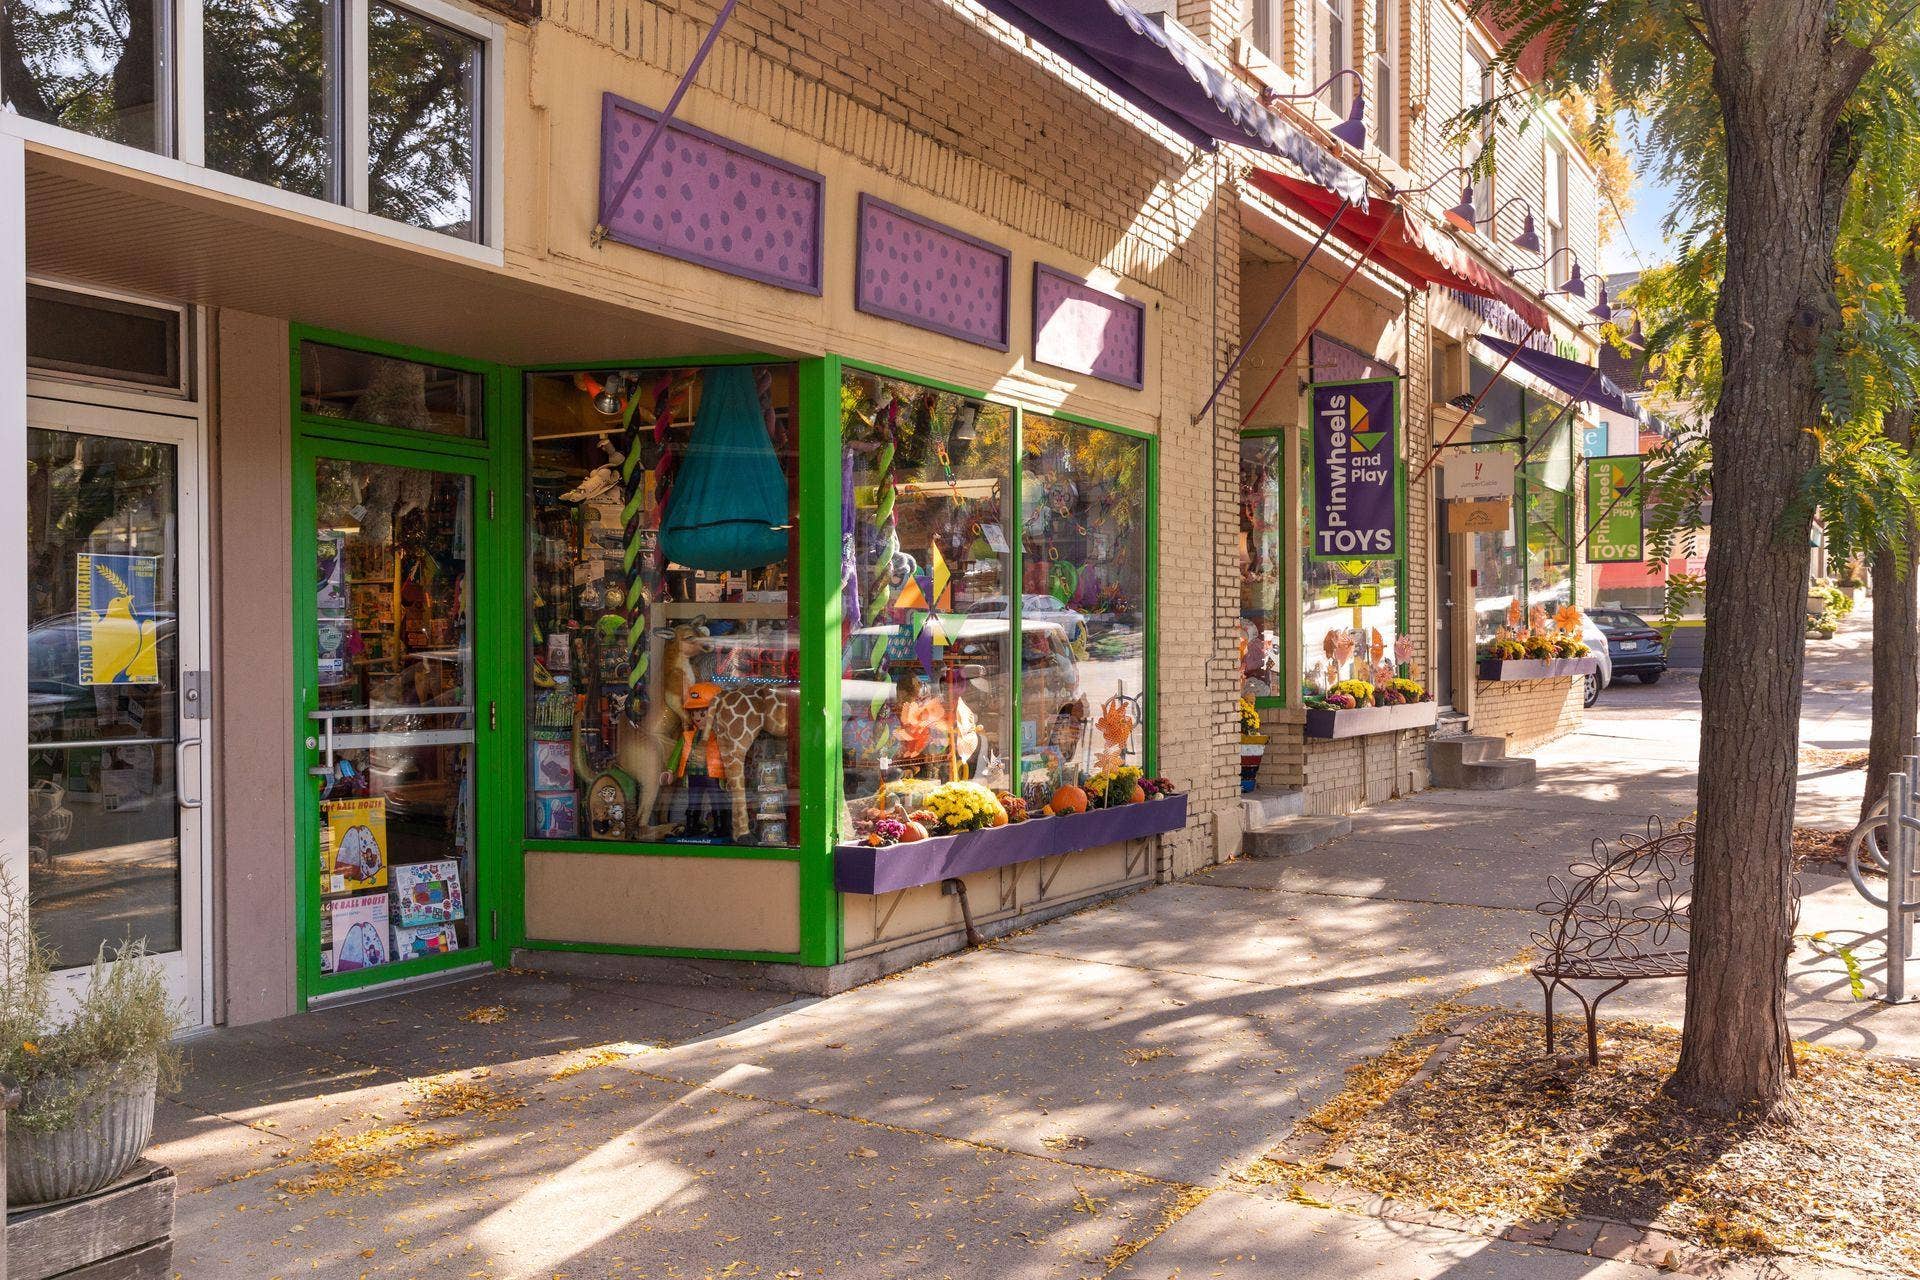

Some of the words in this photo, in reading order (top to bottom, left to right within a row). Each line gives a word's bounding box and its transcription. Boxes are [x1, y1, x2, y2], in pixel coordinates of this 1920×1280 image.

[1321, 394, 1347, 527] Pinwheels
[1351, 453, 1381, 467] and
[1351, 468, 1388, 486] Play
[1594, 464, 1610, 544] Pinwheels
[1612, 508, 1636, 519] Play
[1319, 528, 1392, 552] TOYS
[1591, 544, 1638, 559] TOYS
[78, 555, 91, 607] UKRAINE
[80, 645, 93, 683] STAND
[361, 896, 386, 906] HOUSE
